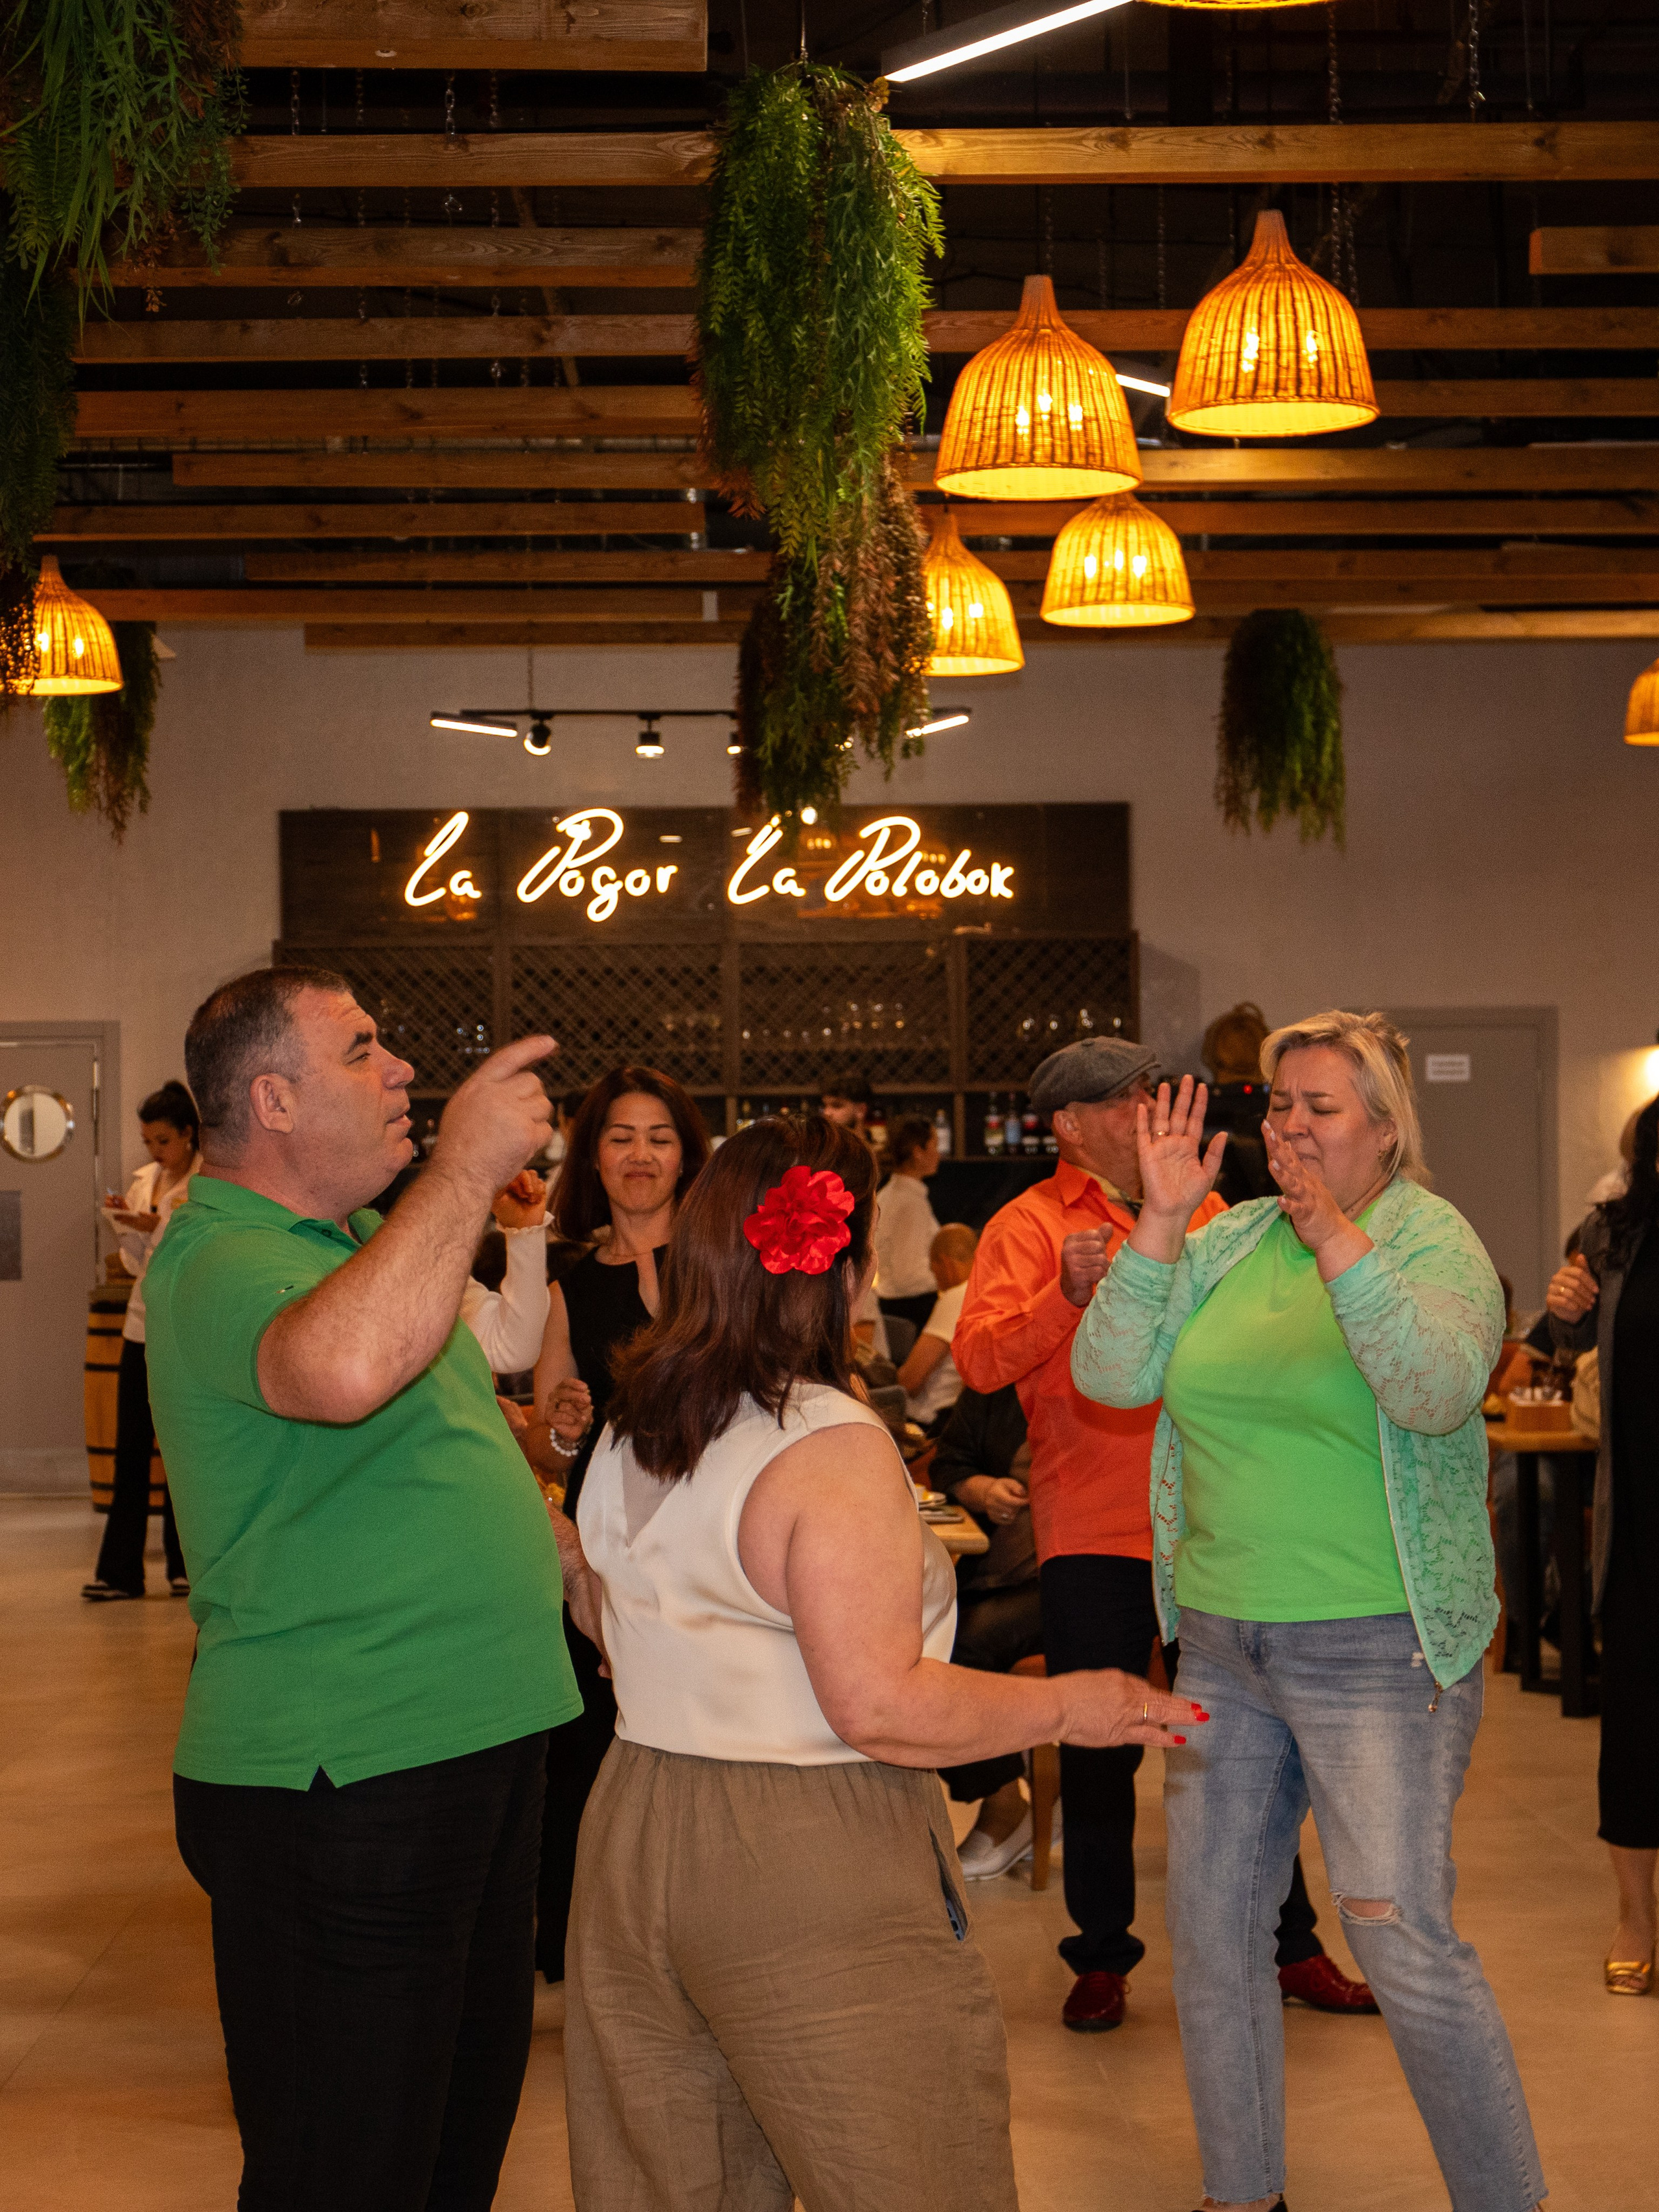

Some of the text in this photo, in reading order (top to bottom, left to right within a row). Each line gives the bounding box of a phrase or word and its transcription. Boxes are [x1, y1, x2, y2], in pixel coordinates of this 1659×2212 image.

[405, 808, 1014, 922] La Pogor La Polobok
